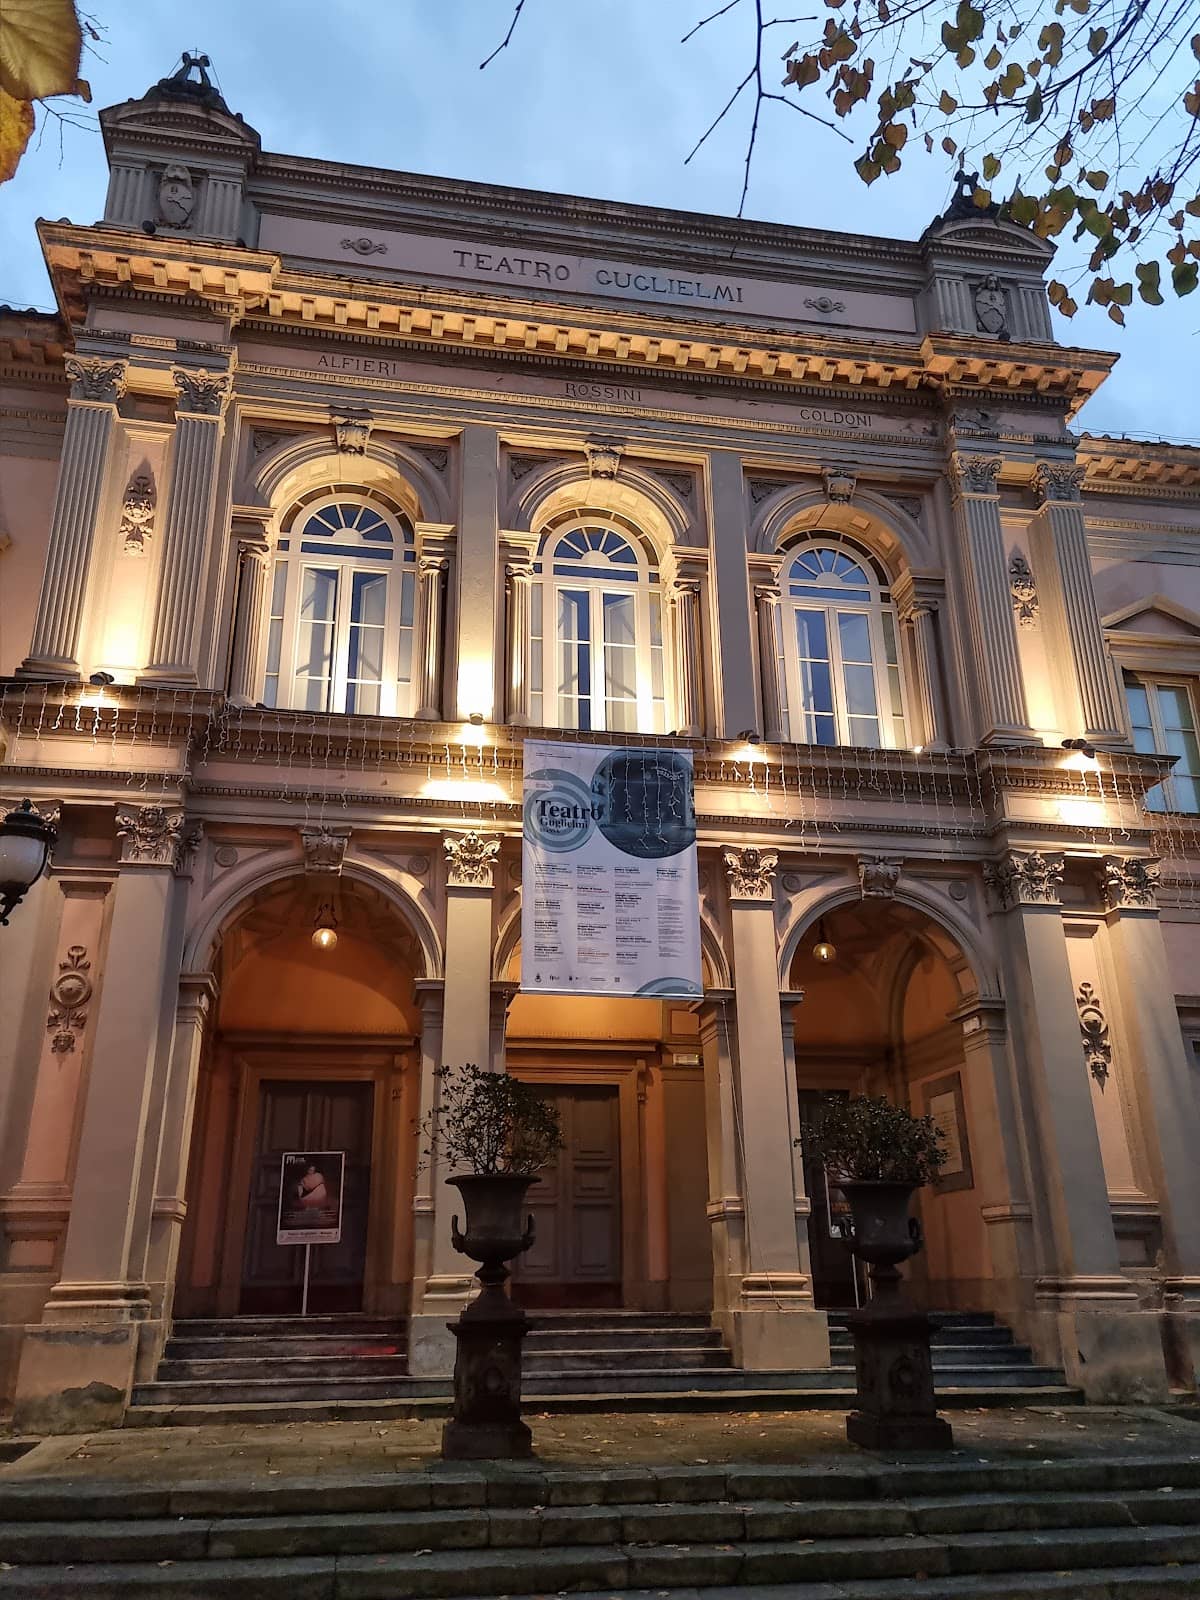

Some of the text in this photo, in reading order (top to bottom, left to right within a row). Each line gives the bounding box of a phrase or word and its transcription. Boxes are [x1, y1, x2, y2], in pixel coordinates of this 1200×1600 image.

[453, 249, 744, 303] TEATRO GUGLIELMI
[318, 354, 397, 377] ALFIERI
[565, 382, 642, 402] ROSSINI
[536, 799, 603, 821] Teatro
[540, 816, 588, 829] Guglielmi
